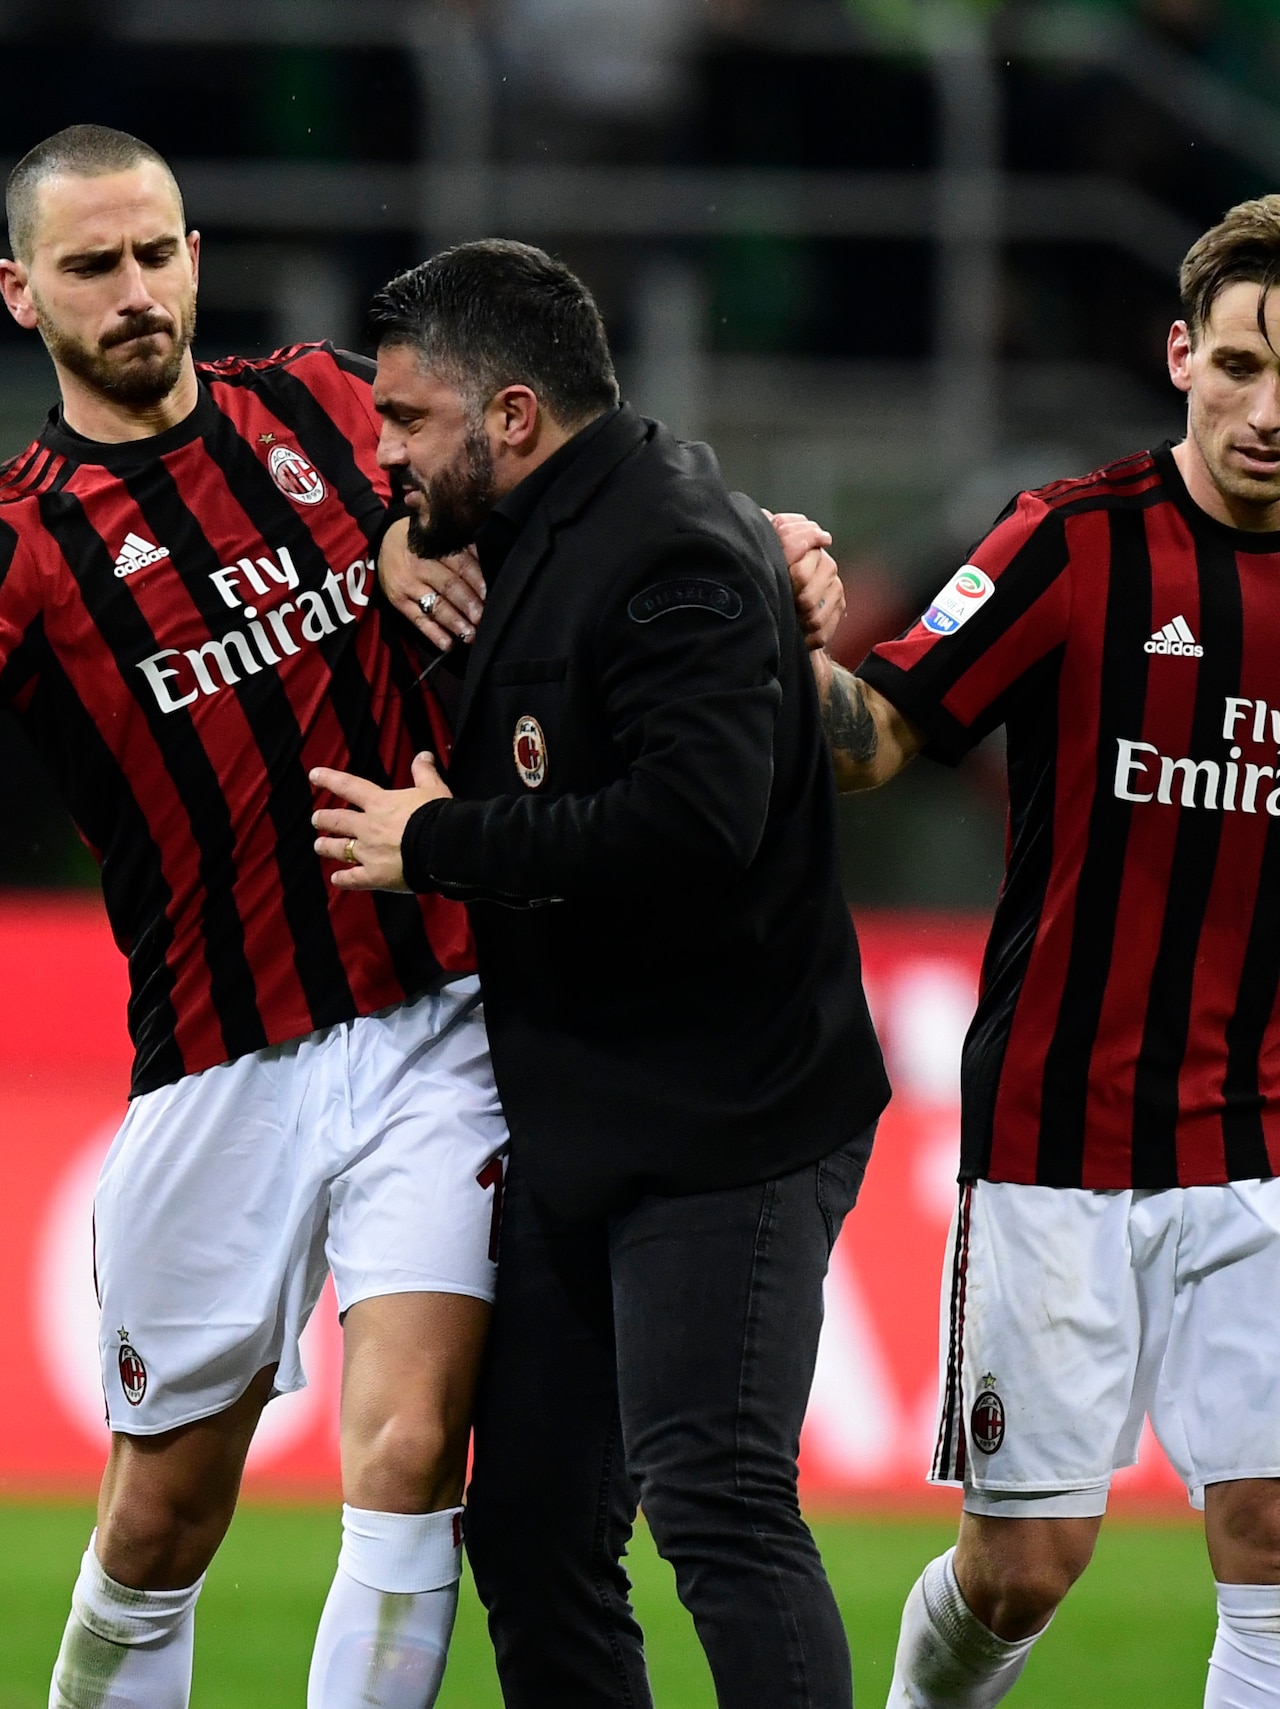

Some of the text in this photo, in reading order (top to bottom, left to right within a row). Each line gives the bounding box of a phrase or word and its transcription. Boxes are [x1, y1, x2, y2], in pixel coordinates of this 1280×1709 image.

[301, 488, 322, 501] 1899
[113, 547, 170, 578] adidas
[208, 546, 300, 608] Fly
[933, 611, 954, 631] TIM
[1143, 639, 1204, 658] adidas
